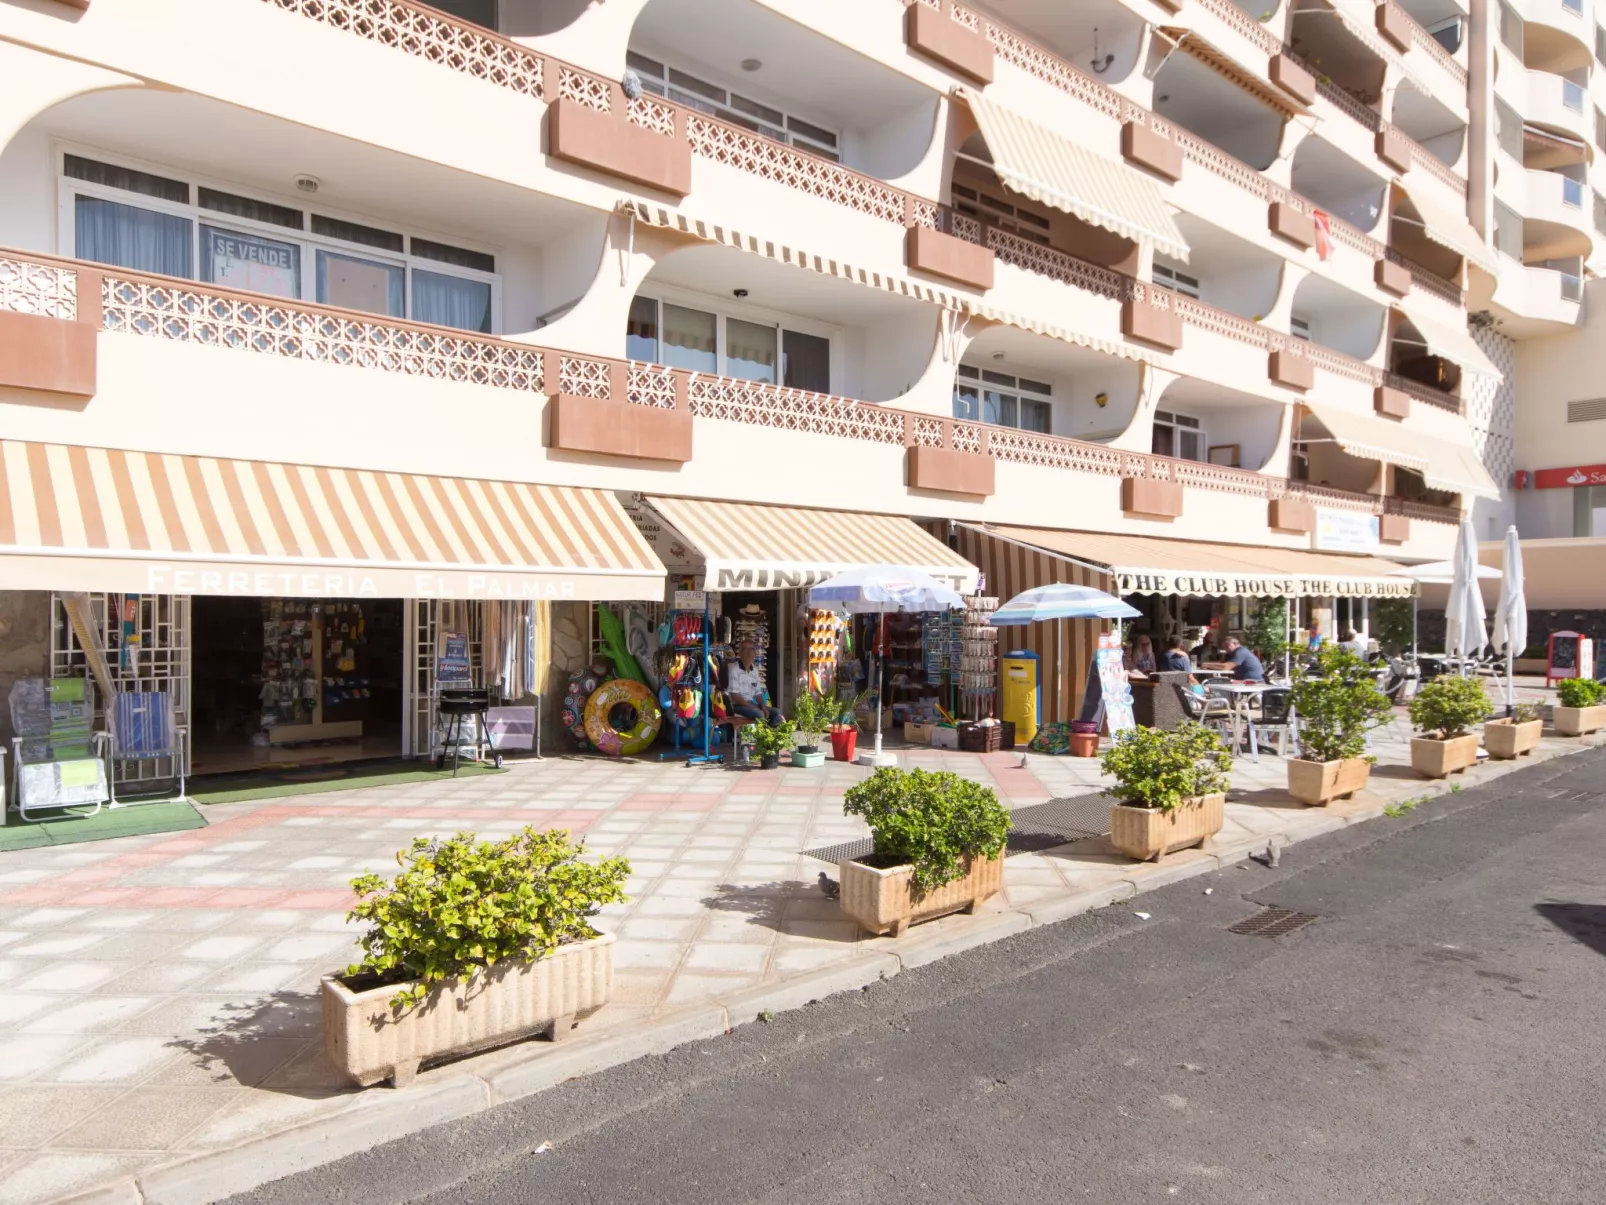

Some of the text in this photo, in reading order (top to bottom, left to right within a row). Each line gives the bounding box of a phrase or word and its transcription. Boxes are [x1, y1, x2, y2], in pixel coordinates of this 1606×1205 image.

[216, 238, 288, 267] SE VENDE
[636, 524, 661, 532] RIADAS
[146, 565, 576, 598] FERRETERÍA EL PALMAR
[1118, 573, 1294, 594] THE CLUB HOUSE
[1300, 579, 1417, 595] THE CLUB HOUSE
